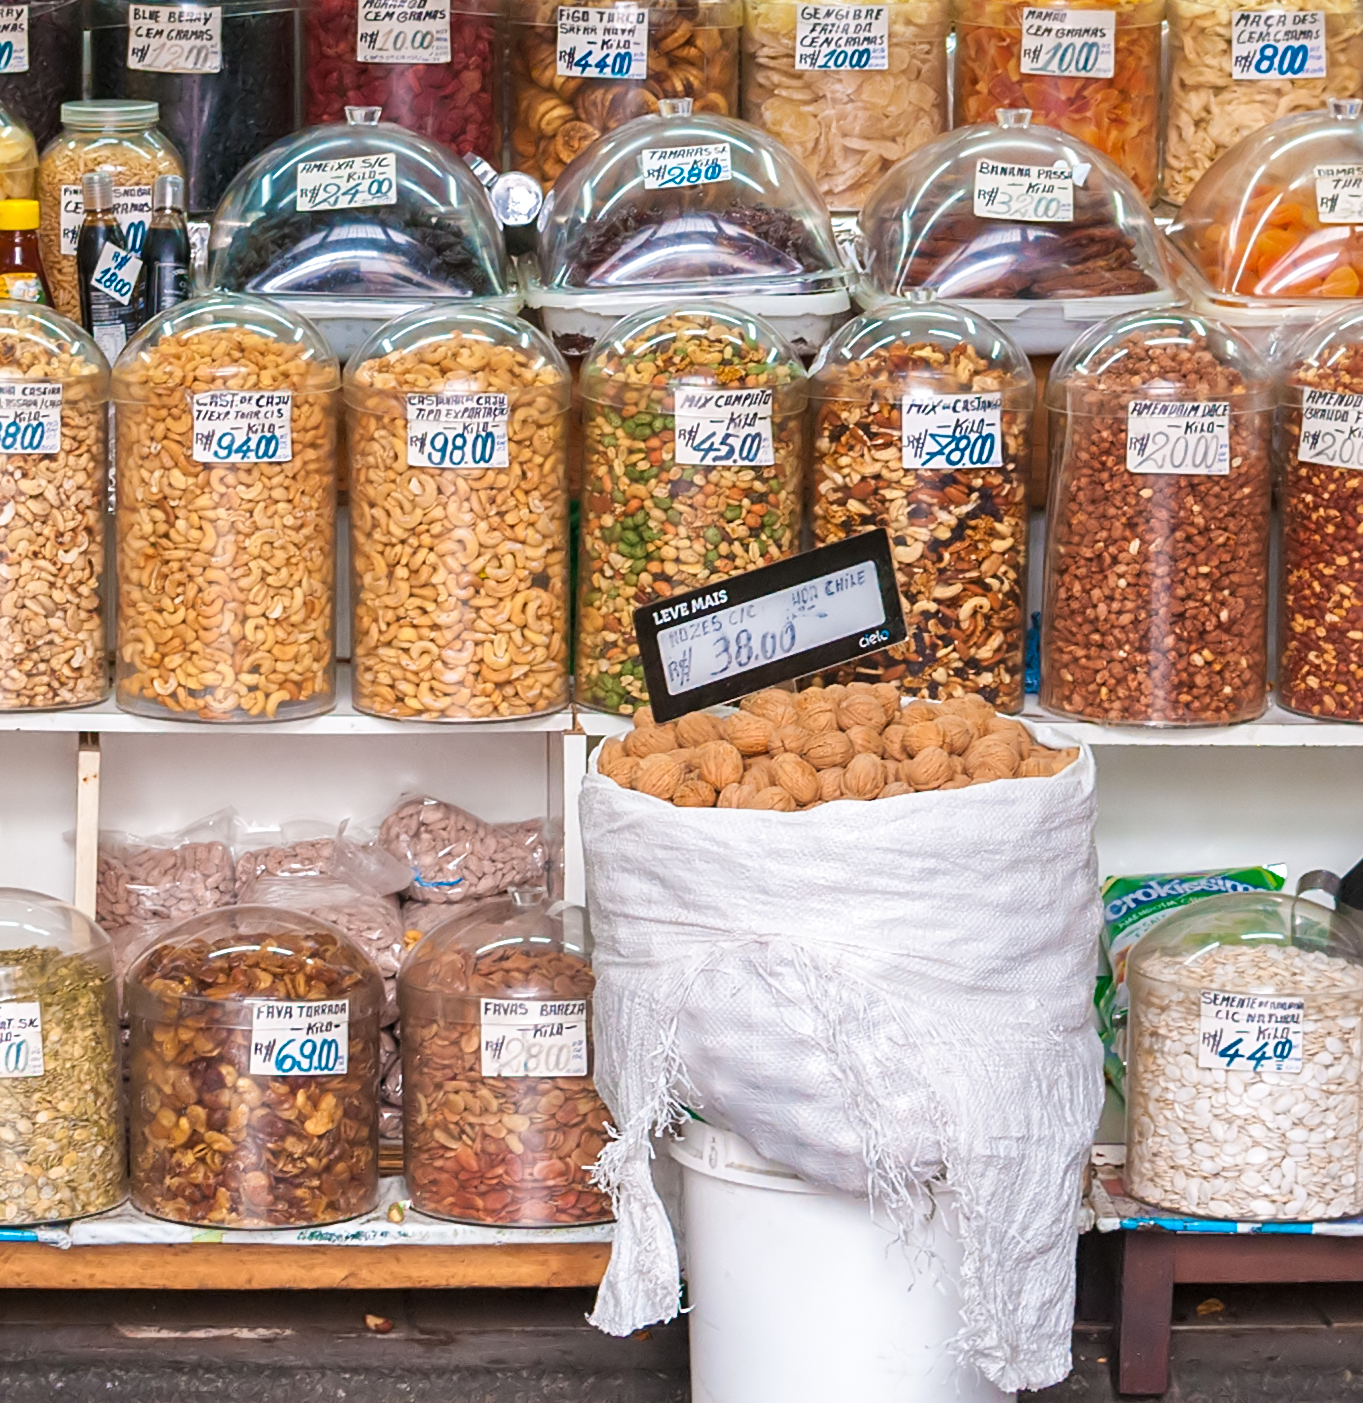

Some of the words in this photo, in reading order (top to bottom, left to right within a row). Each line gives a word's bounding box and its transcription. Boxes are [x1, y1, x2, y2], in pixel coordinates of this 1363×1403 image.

[652, 601, 690, 626] LEVE
[691, 590, 729, 613] MAIS
[859, 628, 890, 648] cielo
[256, 1005, 294, 1019] FAVA
